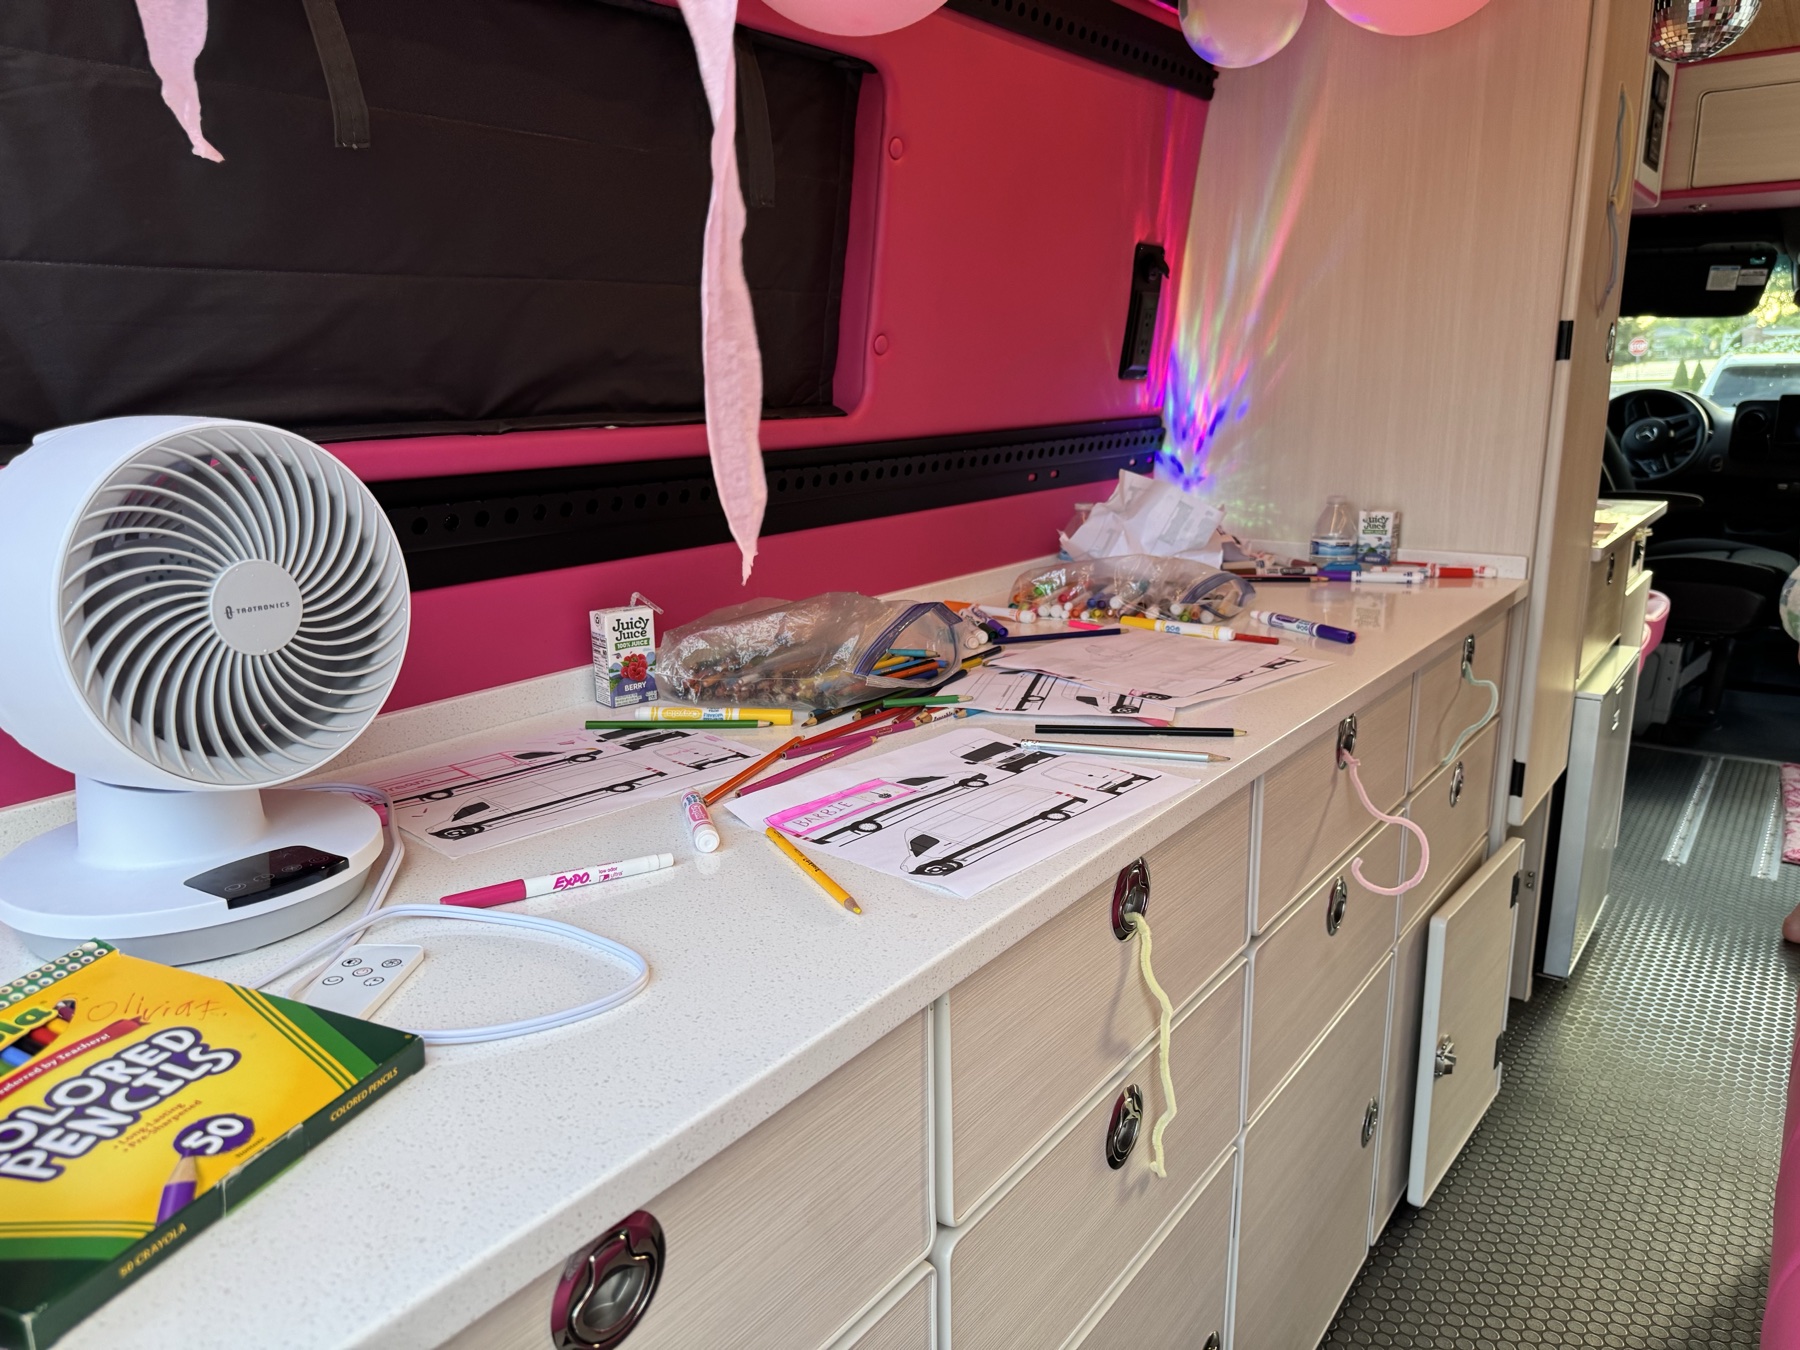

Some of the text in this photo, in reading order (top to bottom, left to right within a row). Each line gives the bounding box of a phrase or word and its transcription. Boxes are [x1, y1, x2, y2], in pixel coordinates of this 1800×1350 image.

[612, 617, 649, 632] Juicy
[616, 629, 647, 641] Juice
[617, 639, 648, 649] 100% JUICE
[624, 681, 647, 692] BERRY
[665, 710, 700, 718] Crayola
[792, 800, 853, 828] BARBIE
[553, 872, 590, 890] EXPO
[43, 1058, 58, 1069] by
[59, 1033, 111, 1061] Teachers!
[0, 1029, 196, 1152] OLORED
[330, 1067, 398, 1121] COLORED PENCILS
[0, 1046, 235, 1179] PENCILS
[180, 1117, 245, 1155] 50
[119, 1223, 187, 1278] 50 CRAYOLA
